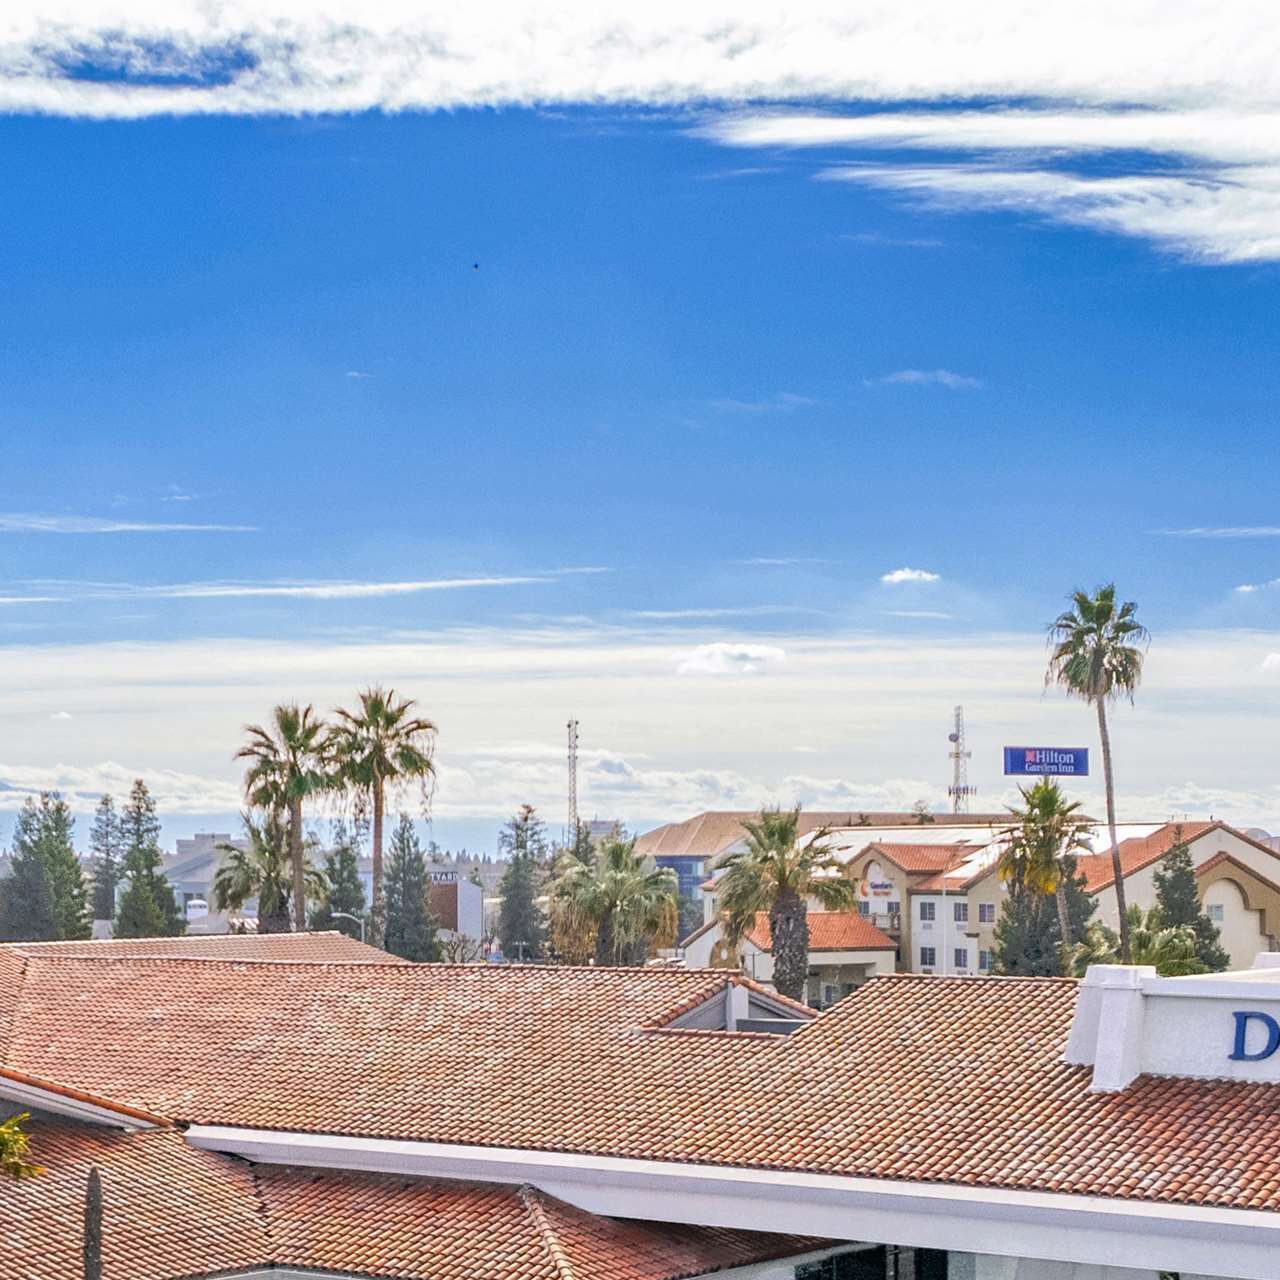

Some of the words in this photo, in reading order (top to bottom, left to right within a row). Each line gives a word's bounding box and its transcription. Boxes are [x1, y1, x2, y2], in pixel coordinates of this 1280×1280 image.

[1036, 750, 1074, 763] Hilton
[1025, 763, 1057, 772] Garden
[1059, 764, 1074, 773] Inn
